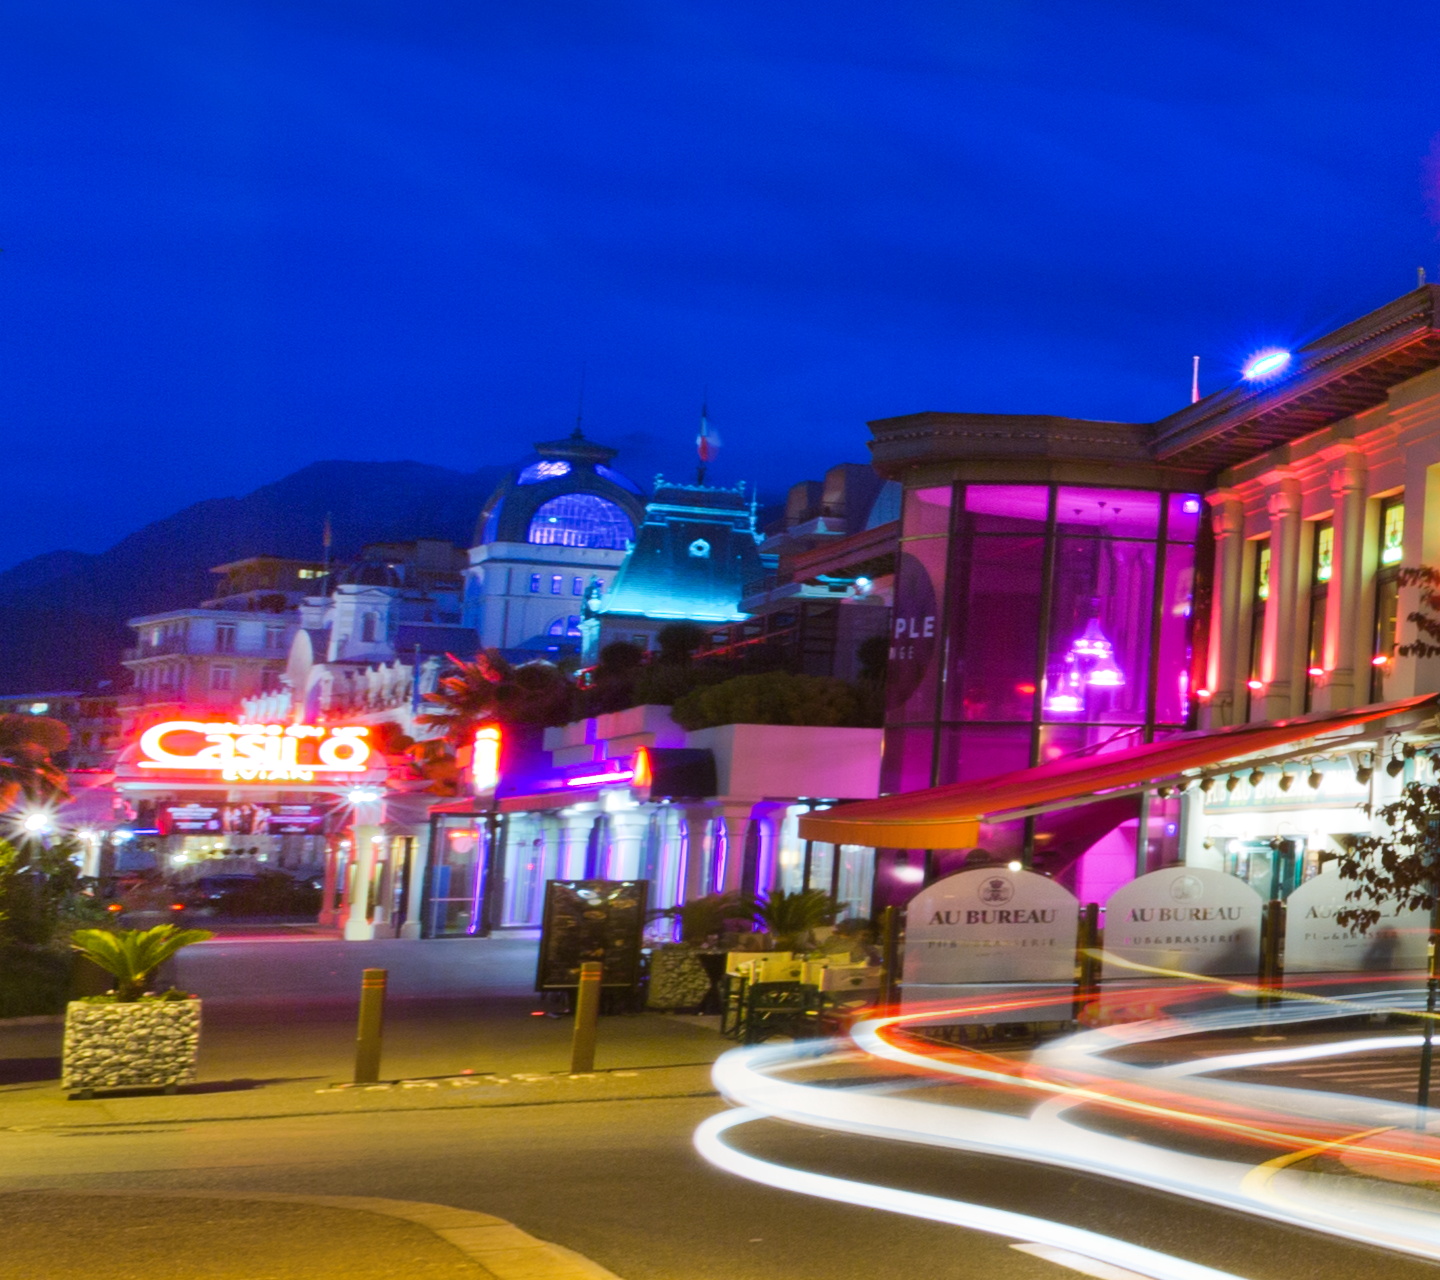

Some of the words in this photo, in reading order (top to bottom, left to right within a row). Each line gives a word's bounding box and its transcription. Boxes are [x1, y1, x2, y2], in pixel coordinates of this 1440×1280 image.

[928, 910, 961, 926] AU
[965, 908, 1058, 925] BUREAU
[1124, 907, 1155, 923] AU
[1158, 905, 1243, 922] BUREAU
